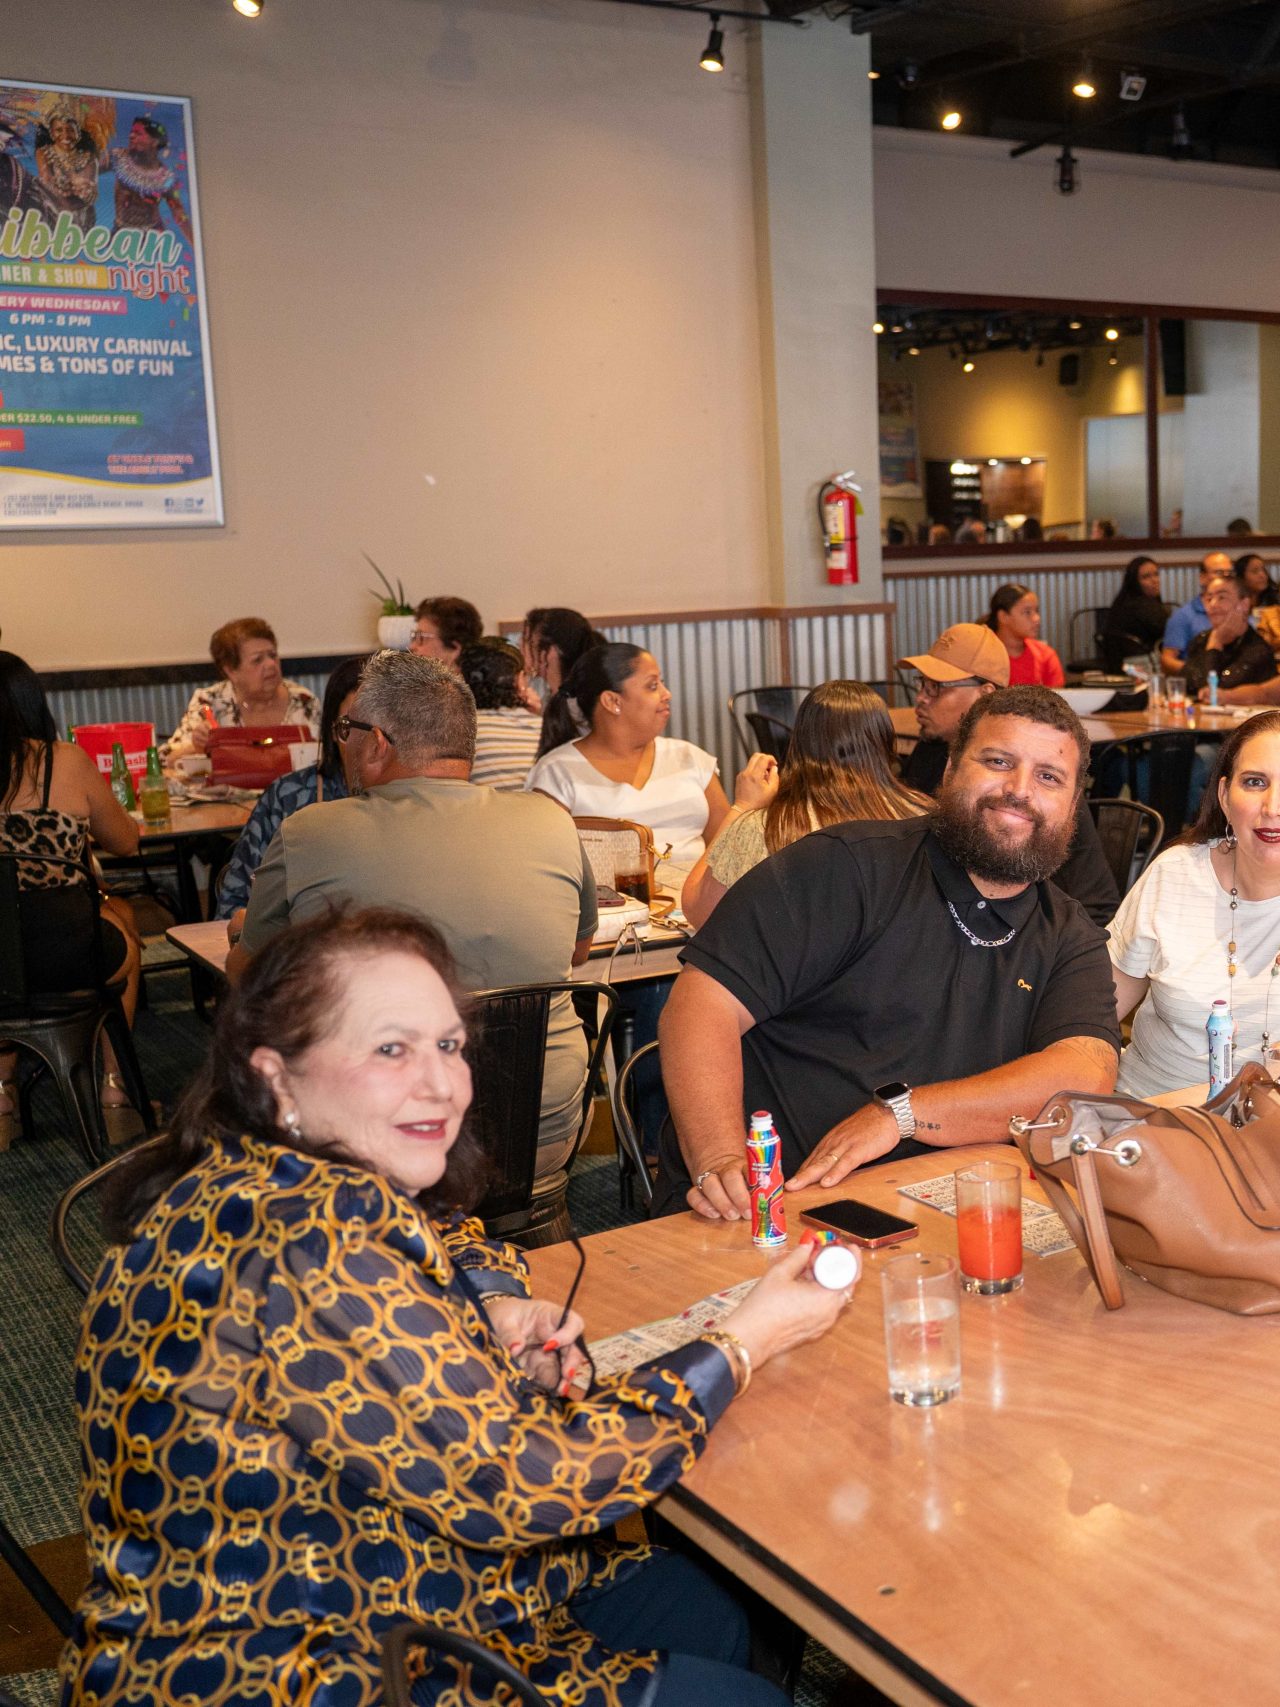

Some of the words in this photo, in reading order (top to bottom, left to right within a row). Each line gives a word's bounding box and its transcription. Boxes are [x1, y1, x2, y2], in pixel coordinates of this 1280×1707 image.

[0, 207, 182, 266] ibbean
[38, 268, 47, 283] &
[54, 267, 97, 287] SHOW
[108, 261, 190, 299] night
[31, 297, 121, 311] WEDNESDAY
[9, 313, 19, 325] 6
[22, 313, 45, 326] PM
[56, 314, 65, 326] 8
[68, 315, 91, 328] PM
[25, 335, 99, 354] LUXURY
[104, 337, 193, 357] CARNIVAL
[40, 356, 55, 374] &
[58, 357, 108, 375] TONS
[112, 359, 135, 375] OF
[138, 360, 174, 376] FUN
[0, 412, 15, 423] ER
[77, 414, 111, 424] UNDER
[113, 415, 137, 425] FREE
